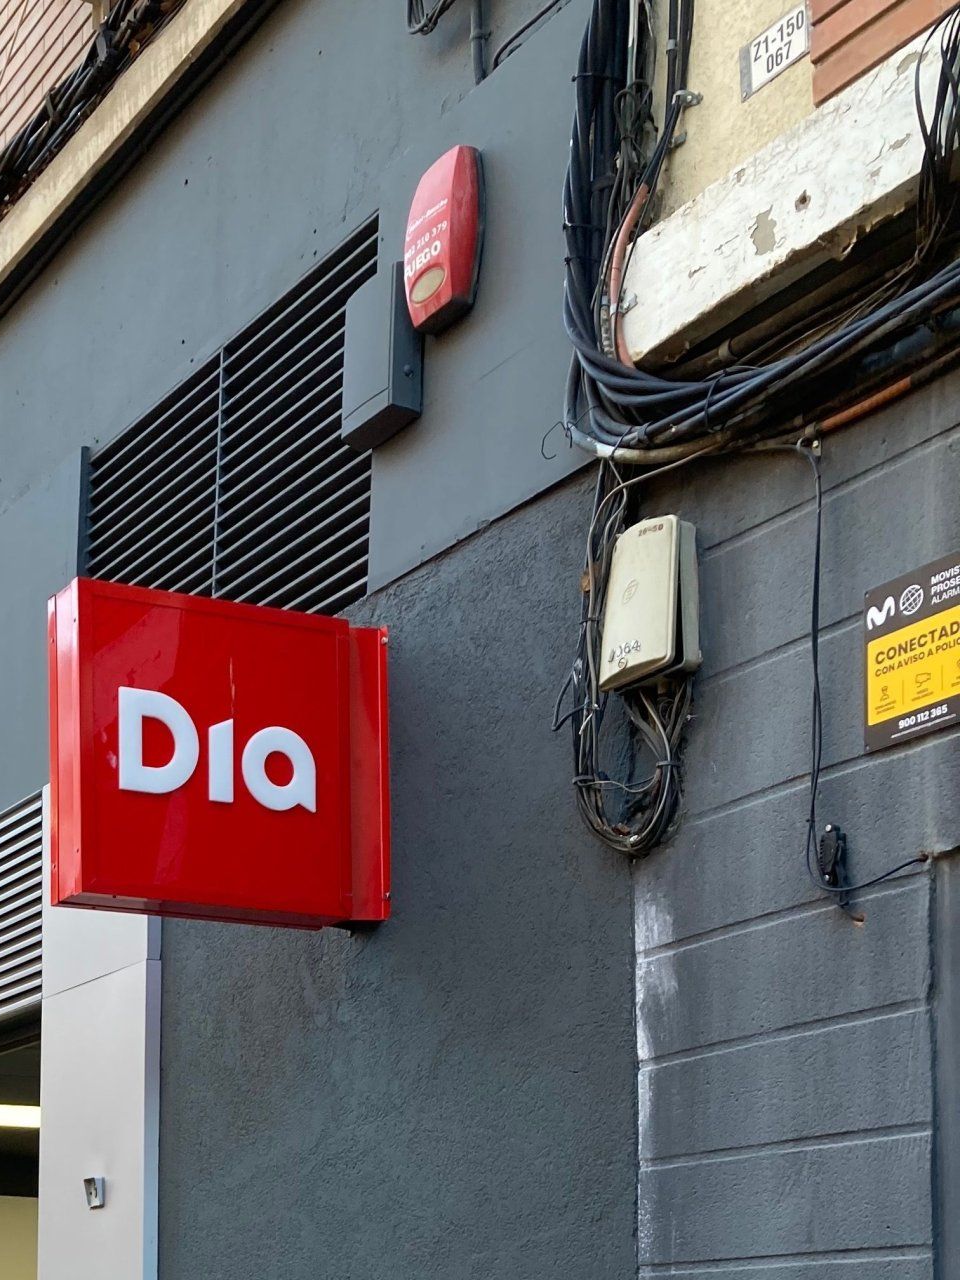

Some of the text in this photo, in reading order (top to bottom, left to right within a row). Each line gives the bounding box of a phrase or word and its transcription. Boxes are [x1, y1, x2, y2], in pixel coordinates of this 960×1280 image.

[753, 10, 804, 63] Z1-150
[766, 40, 792, 73] 067
[931, 565, 960, 585] MOVIS
[931, 575, 960, 595] PROSE
[931, 586, 960, 605] ALARM
[875, 620, 960, 665] CONECTAD
[875, 637, 960, 677] CON AVISO A POLIC
[898, 716, 916, 729] 900
[916, 710, 930, 722] 112
